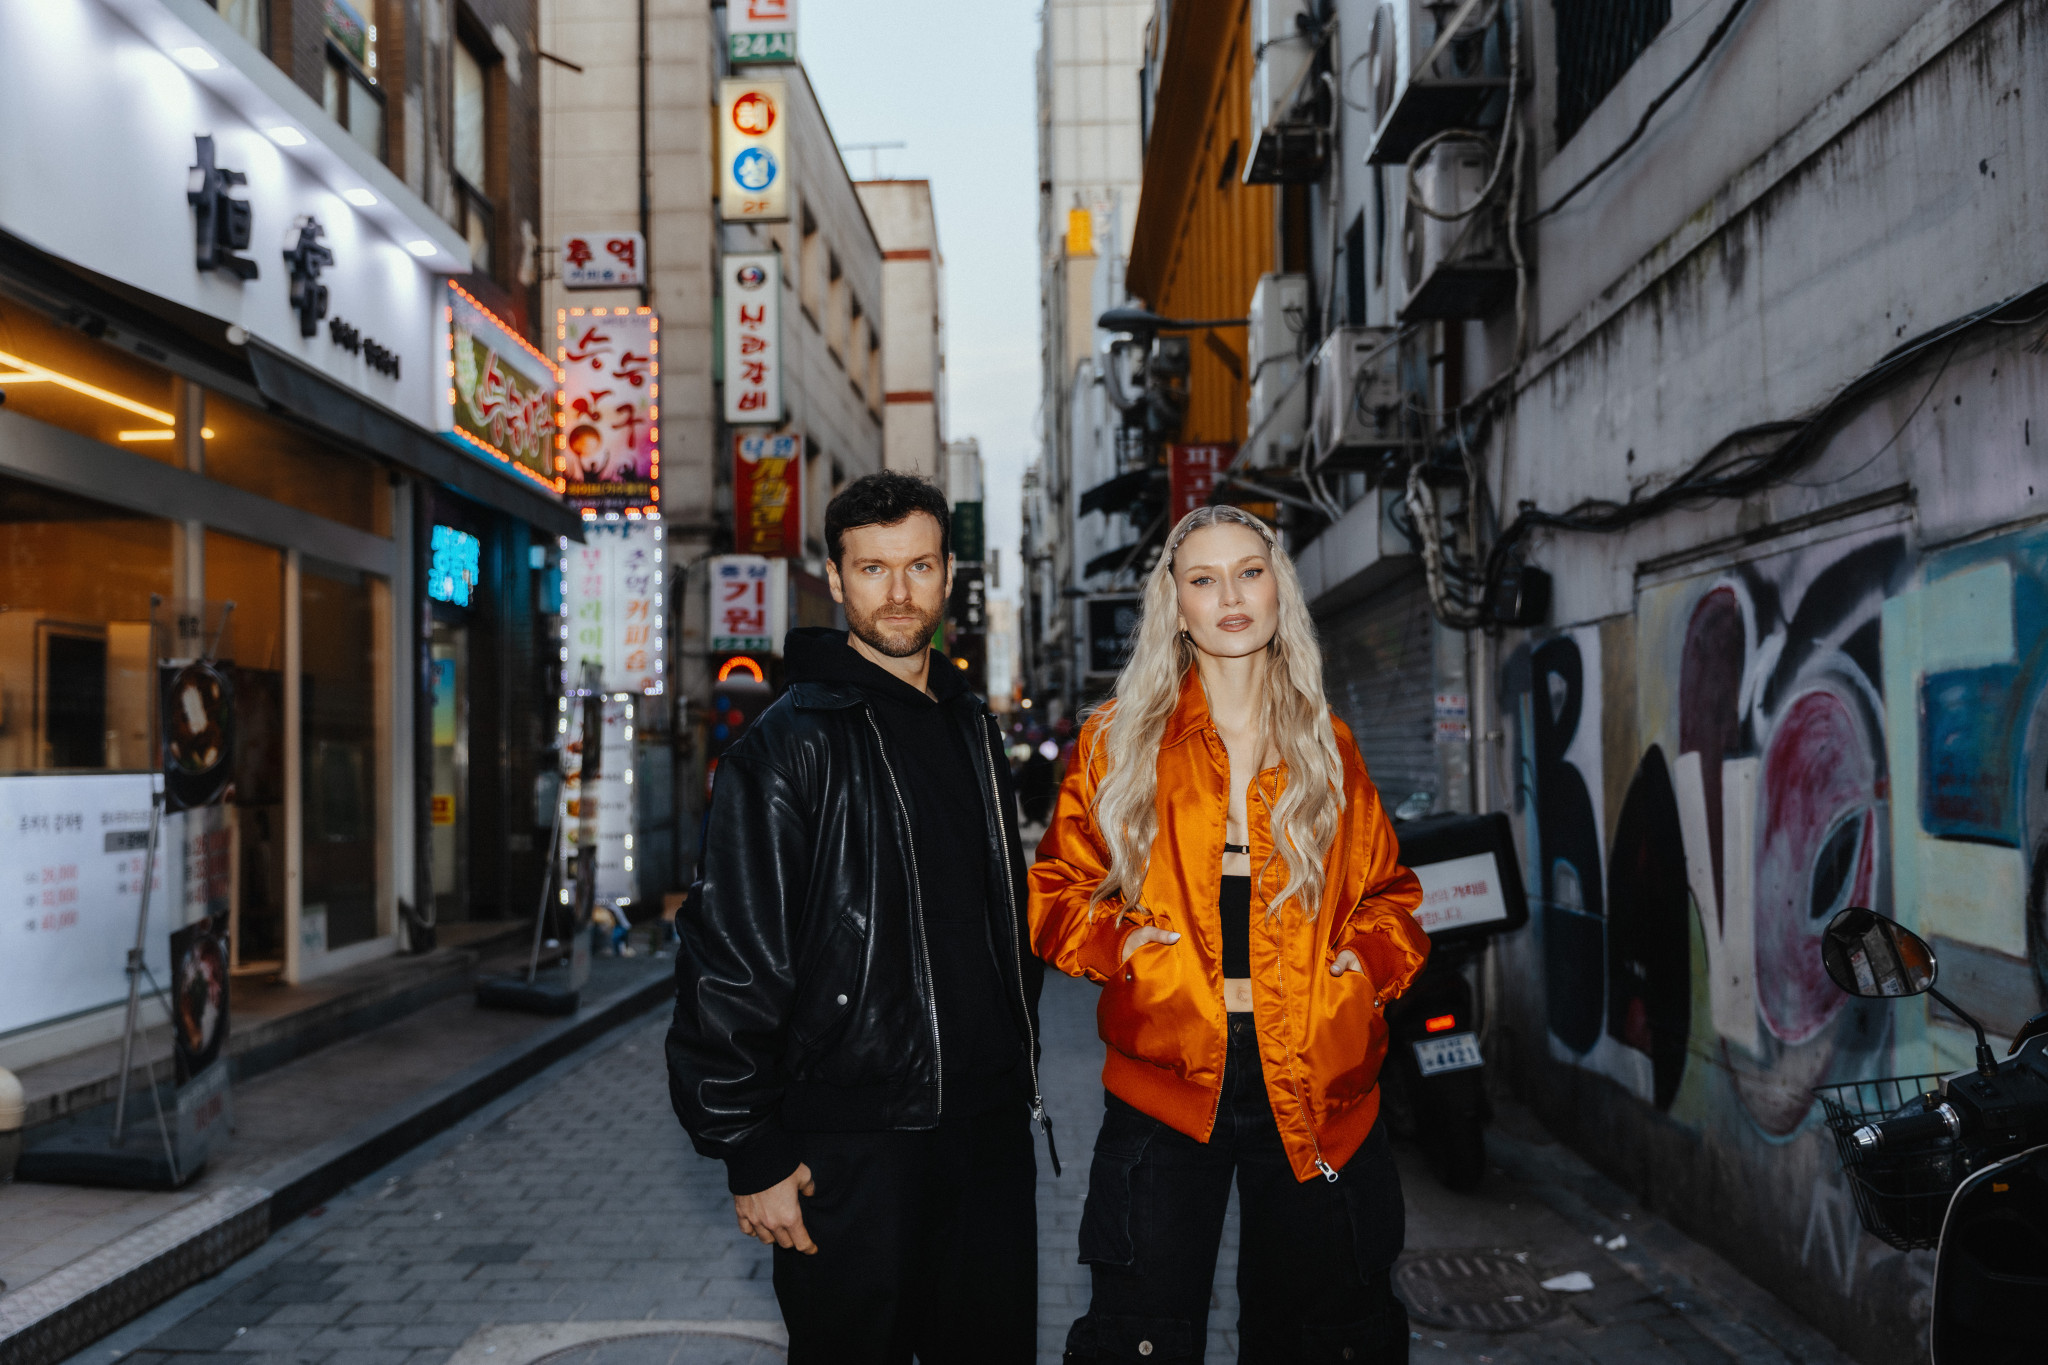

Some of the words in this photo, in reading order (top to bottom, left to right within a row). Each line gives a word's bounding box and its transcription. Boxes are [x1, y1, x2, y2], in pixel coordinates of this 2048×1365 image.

[734, 33, 793, 58] 24시
[566, 238, 636, 269] 추억
[722, 579, 766, 635] 기원
